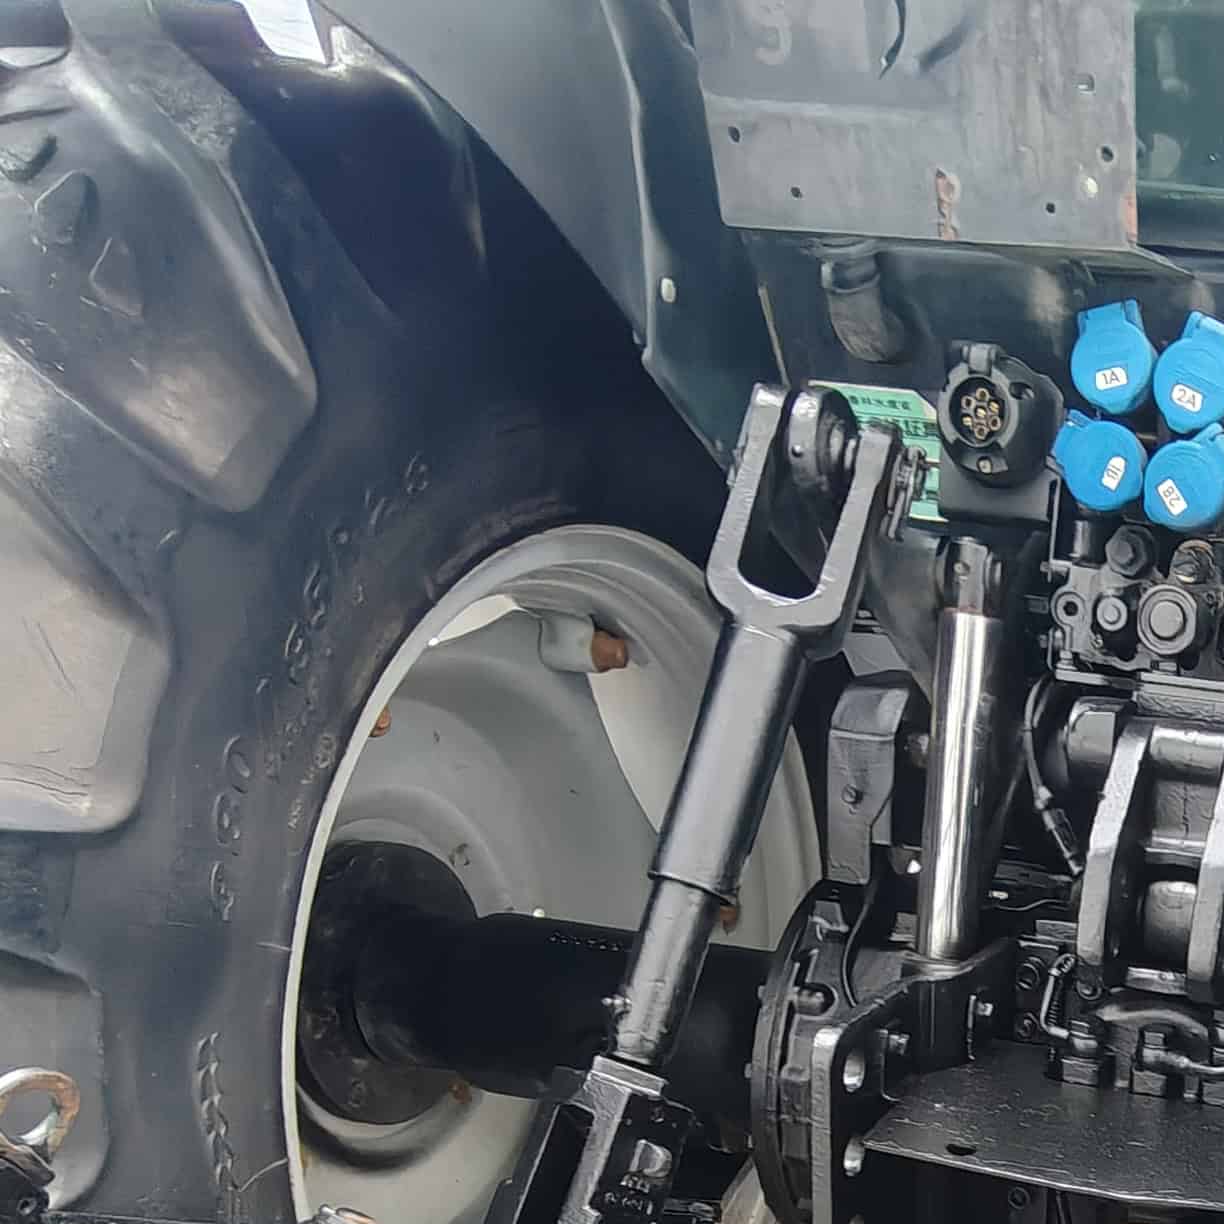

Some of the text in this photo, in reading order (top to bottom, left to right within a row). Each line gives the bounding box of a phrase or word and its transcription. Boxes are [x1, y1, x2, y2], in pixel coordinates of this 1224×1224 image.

[1101, 369, 1121, 385] 1A
[1176, 387, 1198, 409] 2A
[1161, 485, 1180, 509] 2B
